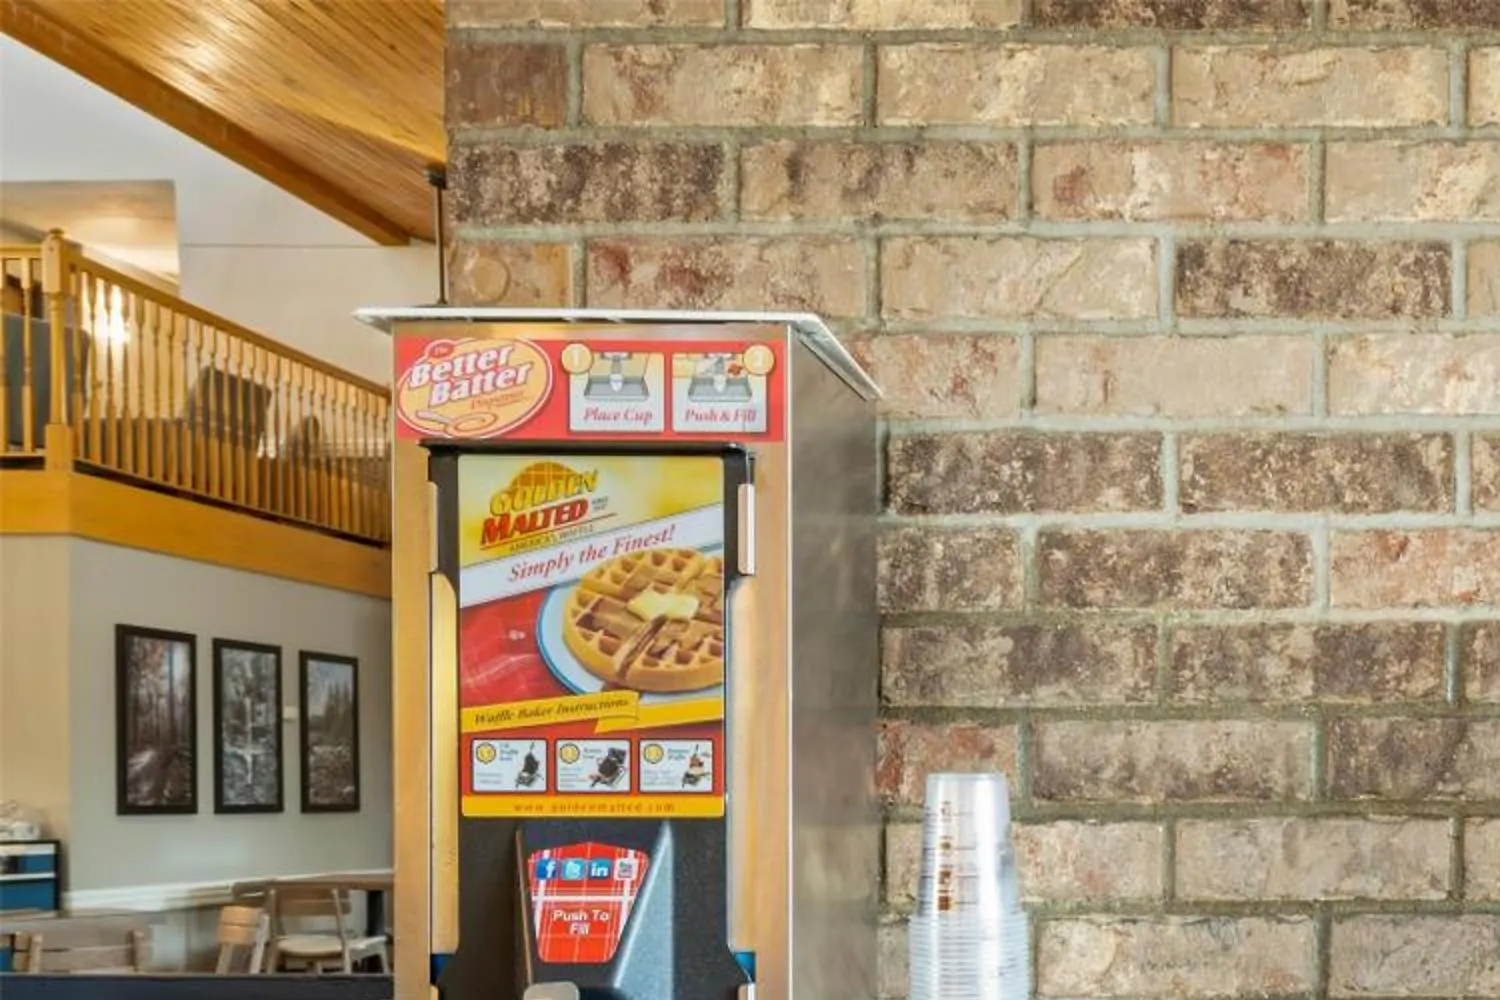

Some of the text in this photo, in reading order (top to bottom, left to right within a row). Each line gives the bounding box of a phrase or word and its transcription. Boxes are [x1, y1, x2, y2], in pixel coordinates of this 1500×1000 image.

[408, 345, 515, 391] Better
[428, 361, 534, 409] Batter
[583, 406, 653, 425] Place Cup
[684, 408, 720, 423] Push
[733, 408, 757, 423] Fill
[480, 498, 590, 546] MALTED
[508, 523, 676, 583] Simply the Finest!
[553, 910, 610, 921] Push To
[569, 923, 590, 935] Fill
